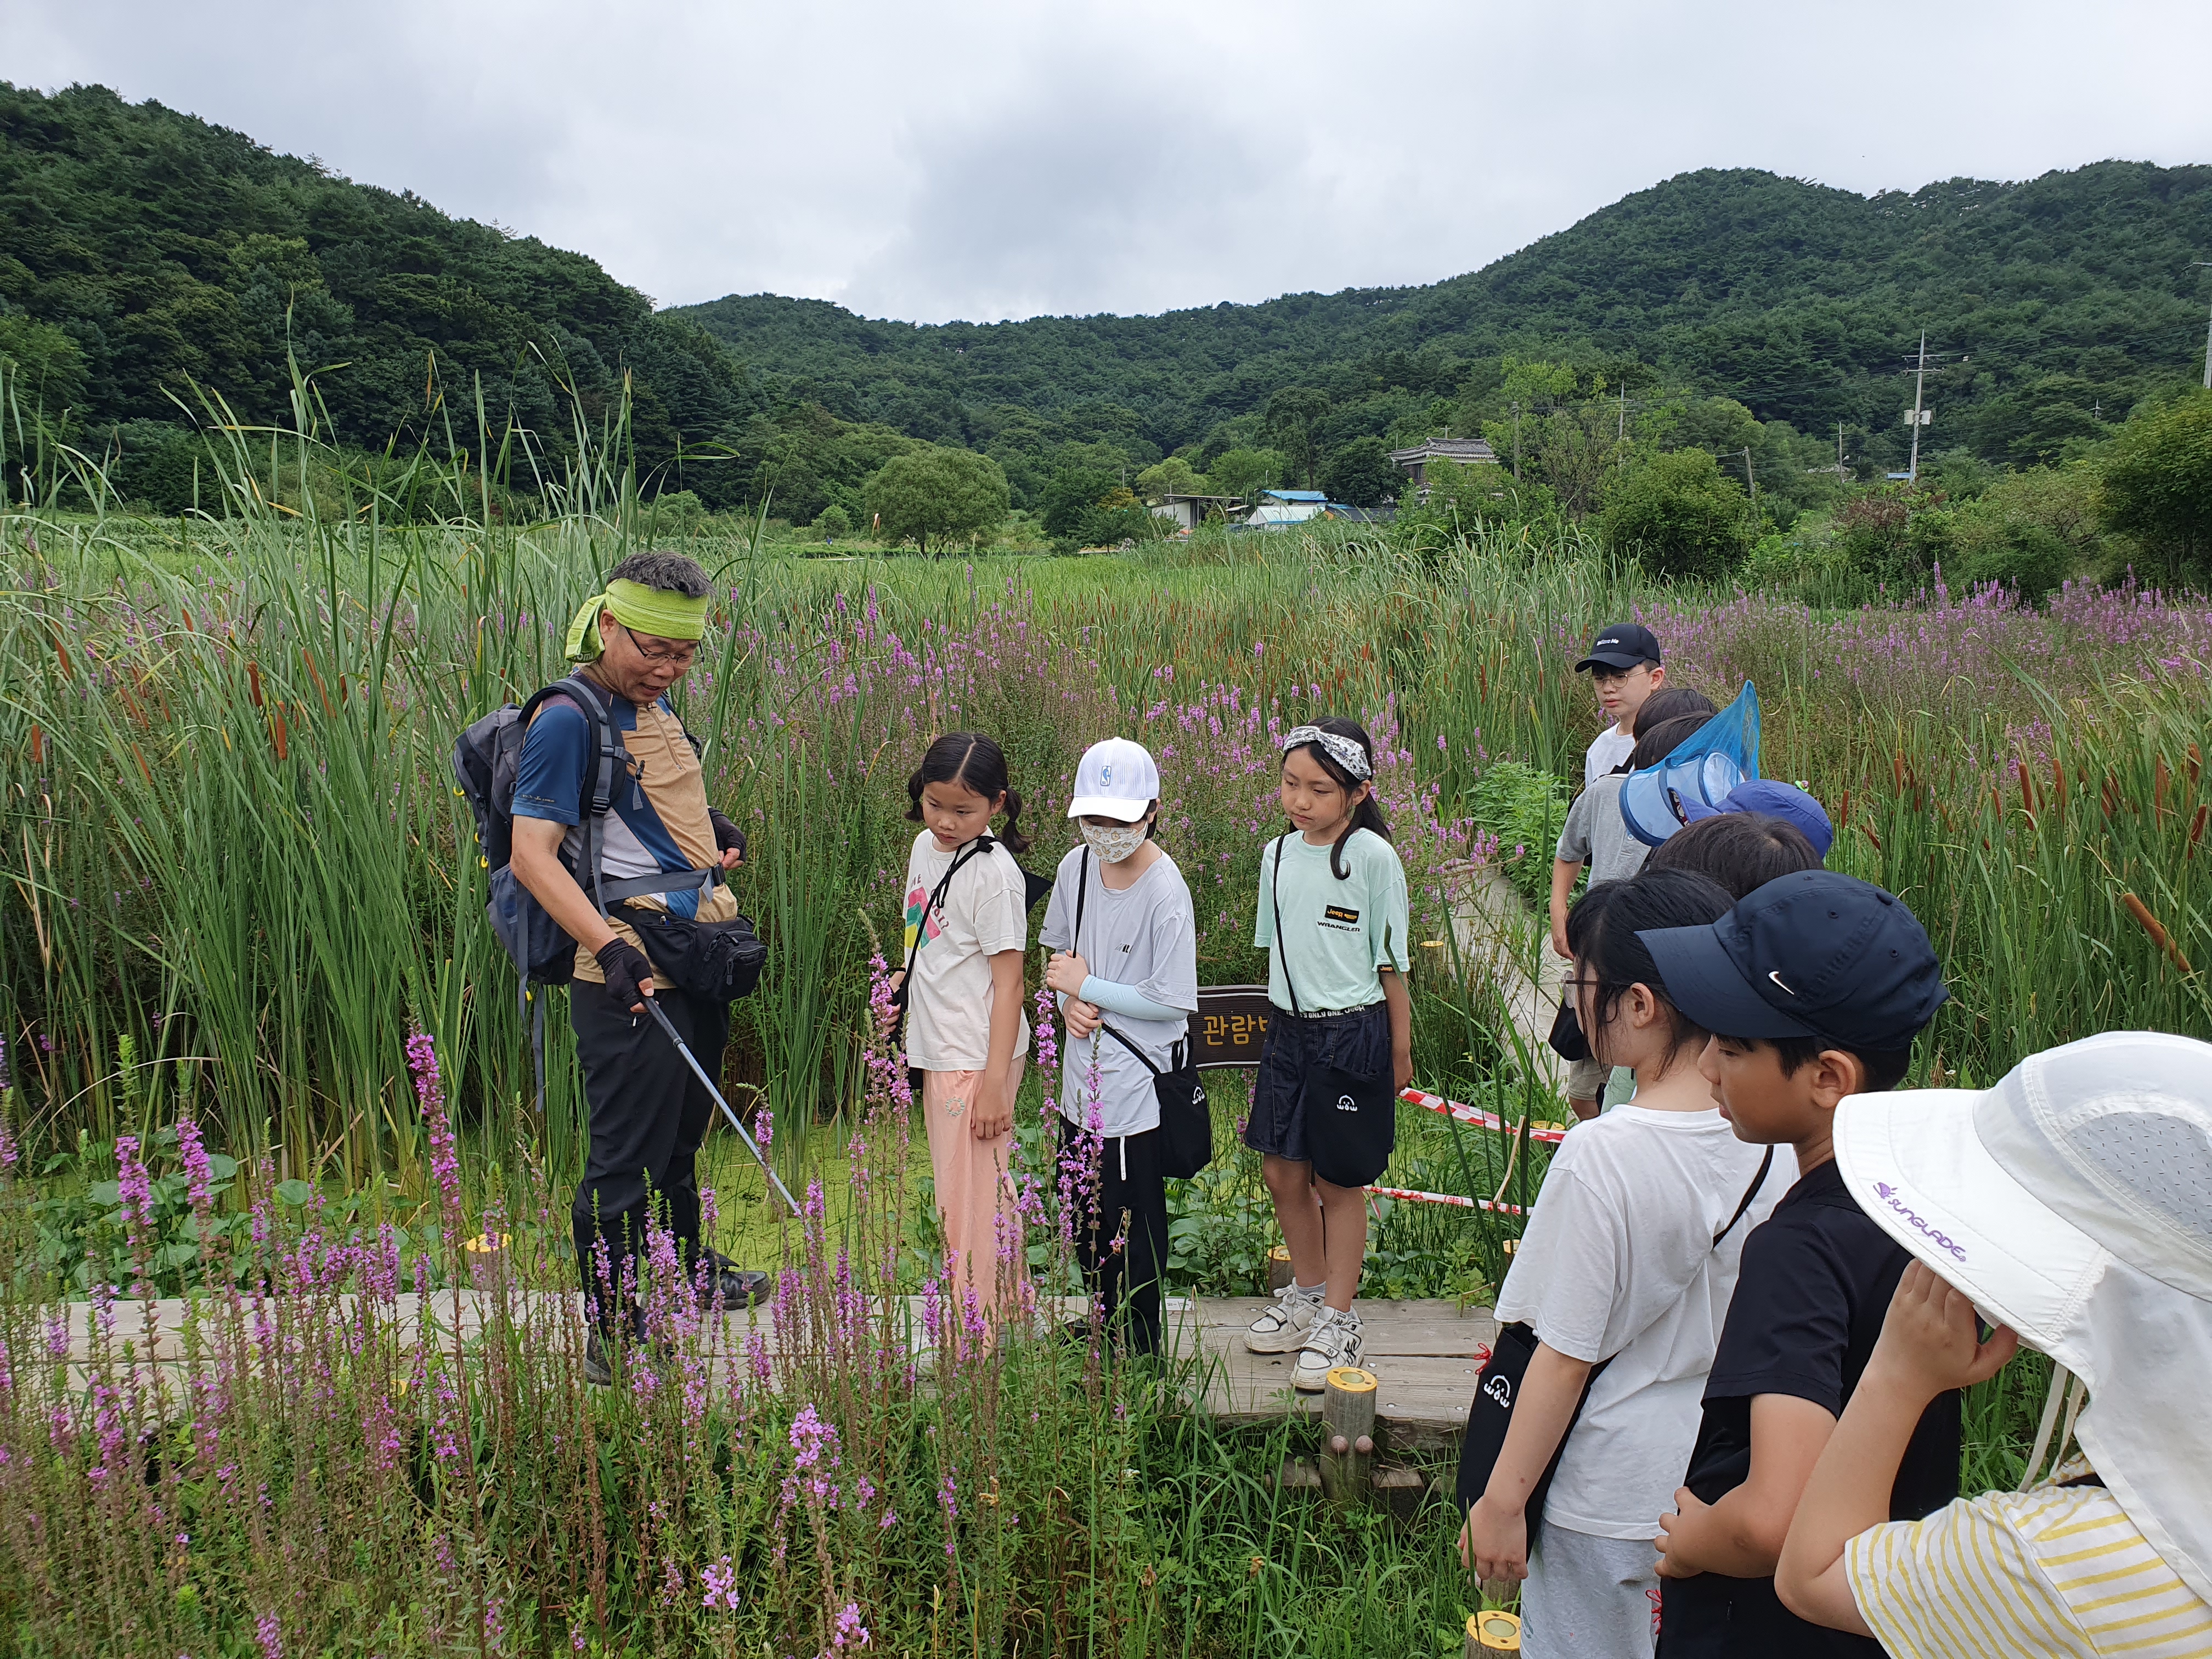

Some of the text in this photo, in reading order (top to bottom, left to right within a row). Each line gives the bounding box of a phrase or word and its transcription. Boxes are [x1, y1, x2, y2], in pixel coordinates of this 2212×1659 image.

[1327, 909, 1344, 918] Jeep
[1317, 921, 1361, 932] WRANGLER
[1344, 1005, 1365, 1014] Jeep
